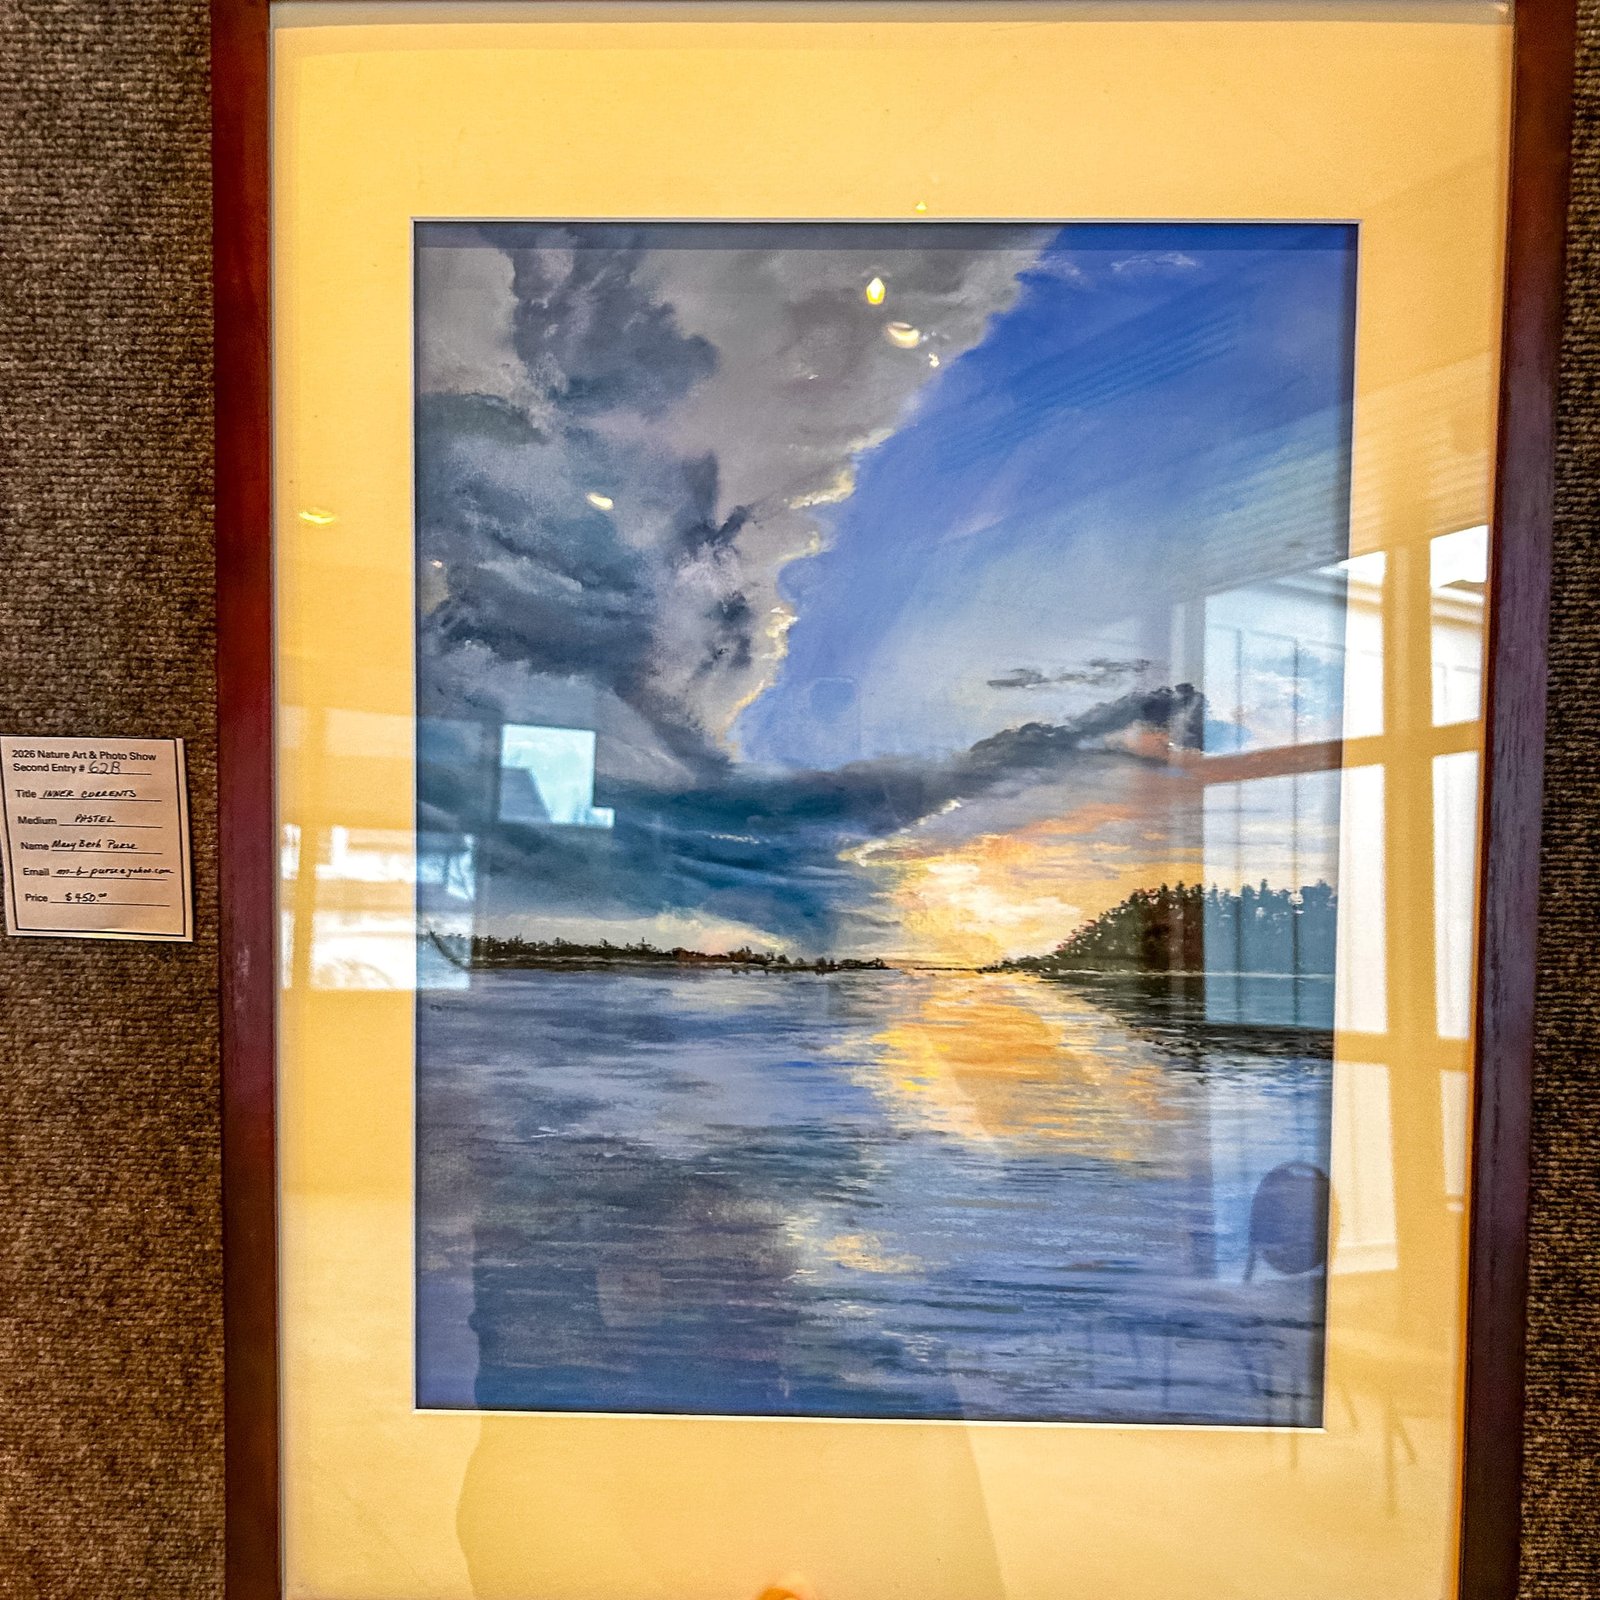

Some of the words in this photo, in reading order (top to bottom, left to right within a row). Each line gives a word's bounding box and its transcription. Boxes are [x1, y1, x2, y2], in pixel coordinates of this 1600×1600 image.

[12, 749, 35, 758] 2026
[37, 750, 70, 759] Nature
[72, 750, 87, 759] Art
[89, 750, 97, 759] &
[100, 751, 128, 760] Photo
[129, 752, 157, 761] Show
[13, 763, 49, 772] Second
[52, 764, 77, 774] Entry
[79, 764, 85, 772] #
[15, 789, 37, 798] Title
[42, 789, 75, 798] INNER
[18, 816, 57, 825] Medium
[74, 813, 116, 823] PASTEL
[20, 842, 49, 850] Name
[51, 839, 77, 851] Mary
[79, 838, 102, 848] Beth
[23, 867, 49, 876] Email
[25, 893, 48, 902] Price
